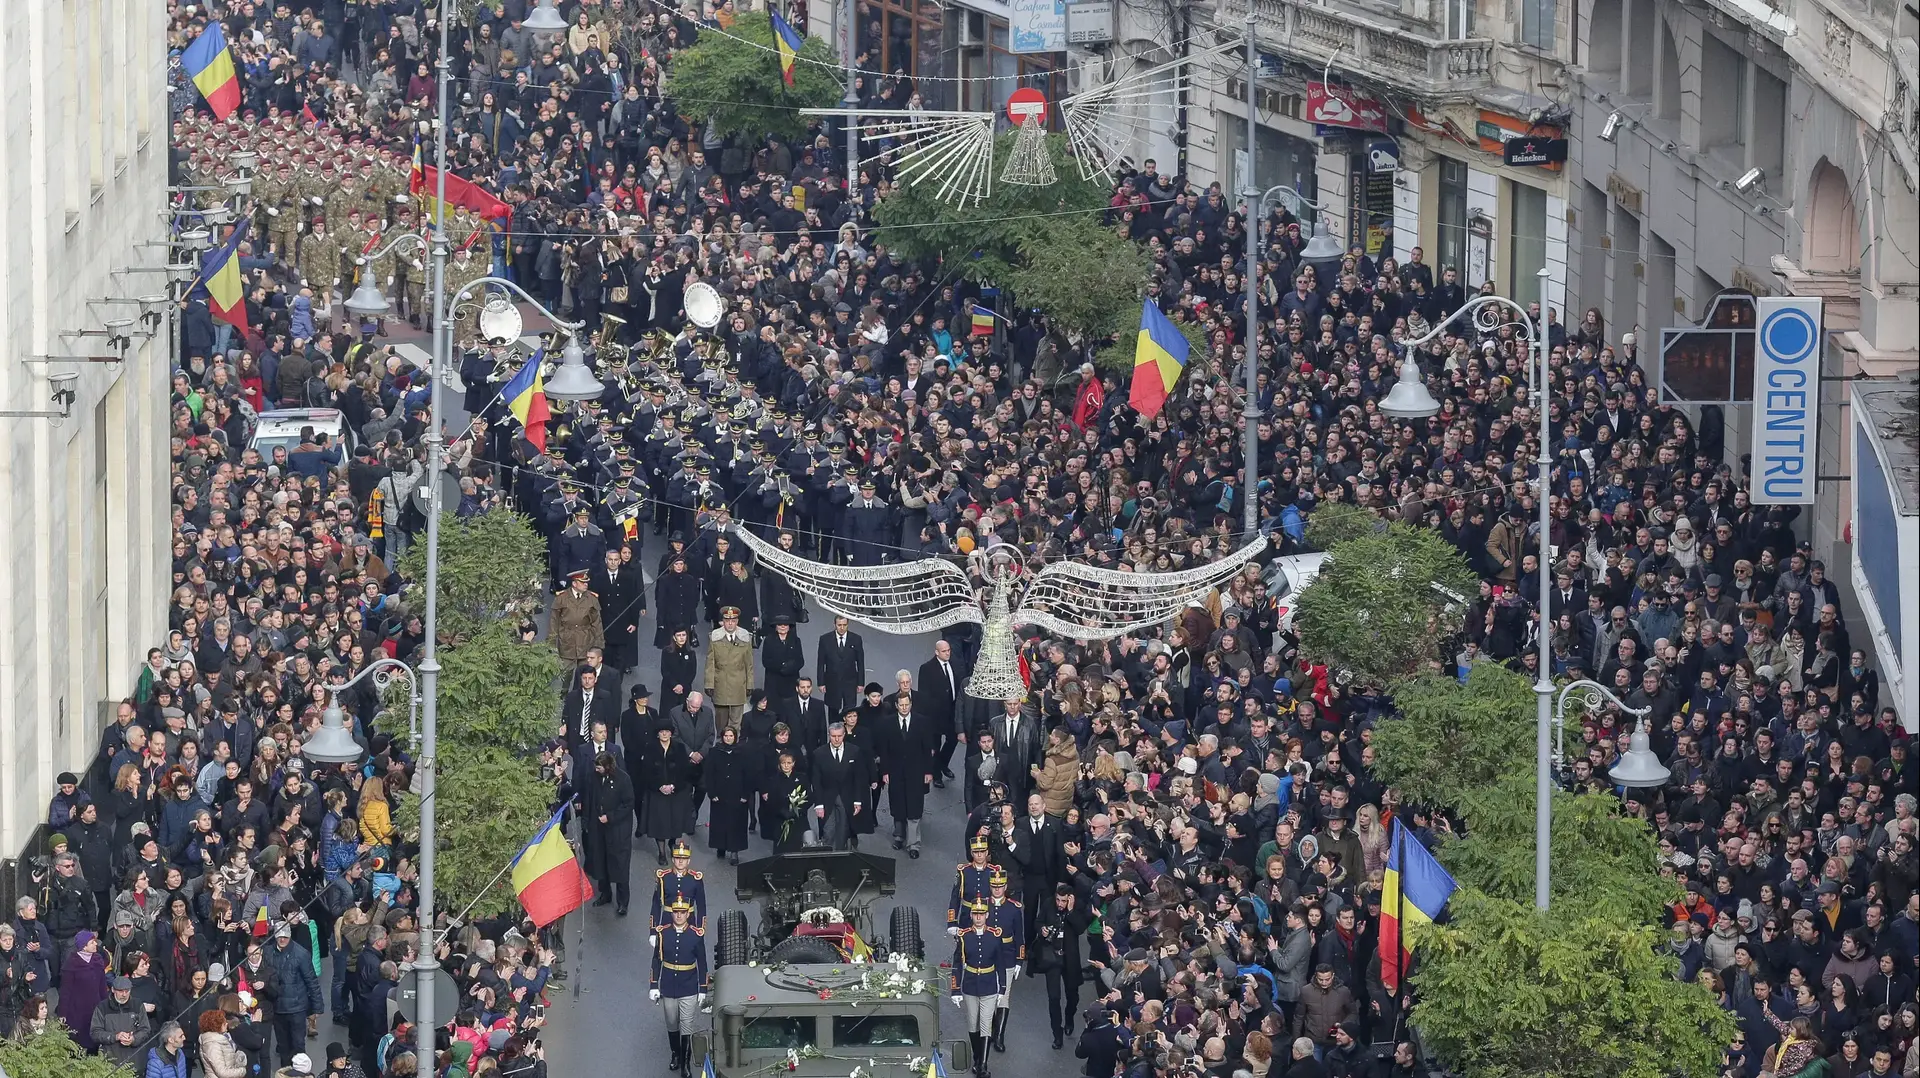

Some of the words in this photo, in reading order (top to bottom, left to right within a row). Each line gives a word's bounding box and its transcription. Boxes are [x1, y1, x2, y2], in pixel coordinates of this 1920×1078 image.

[1014, 0, 1050, 16] Coafura
[1029, 14, 1066, 30] Cosmetic
[1512, 154, 1547, 163] Heineken
[1764, 370, 1807, 498] CENTRU
